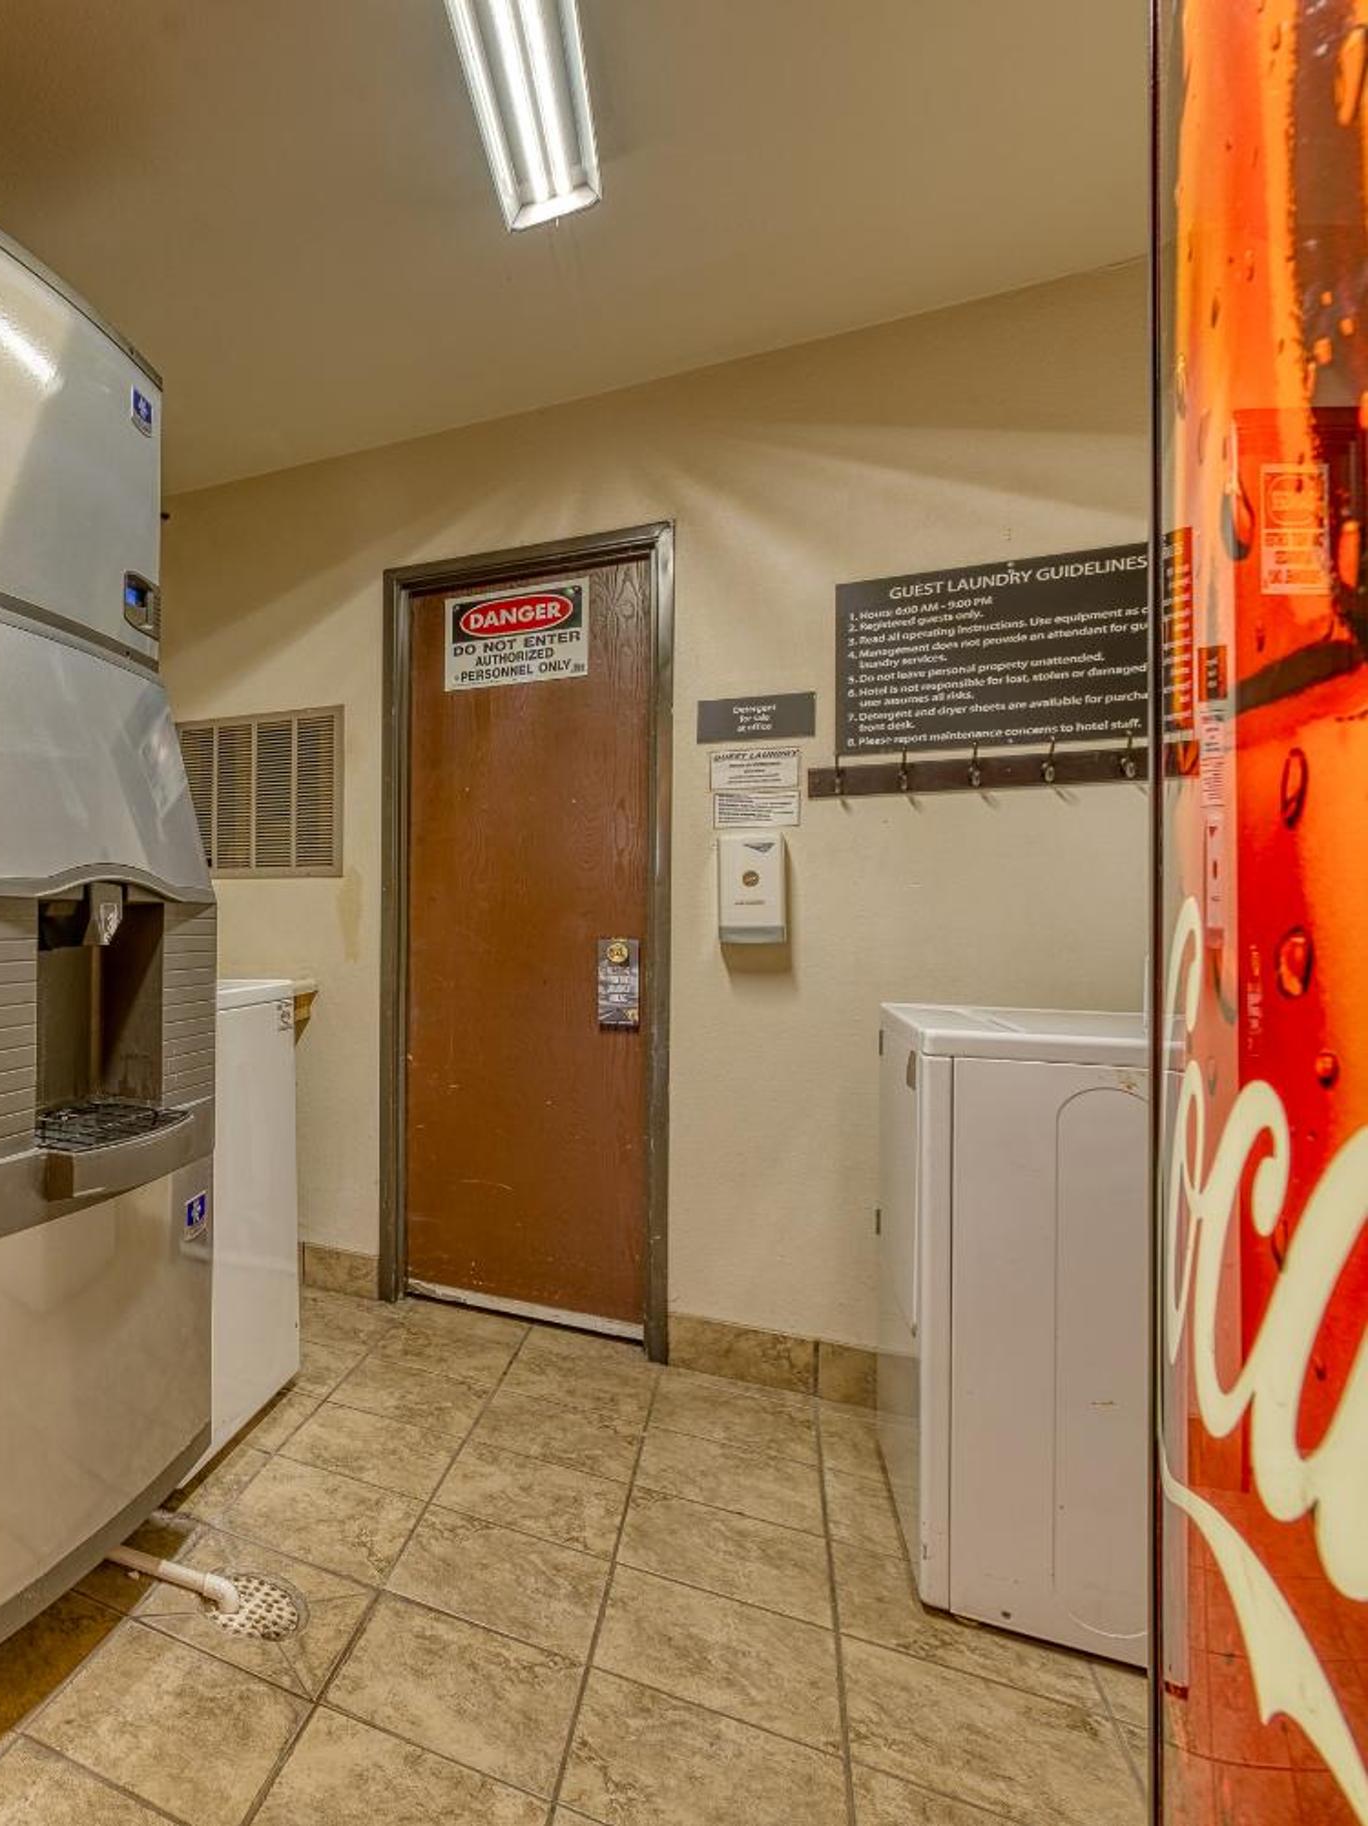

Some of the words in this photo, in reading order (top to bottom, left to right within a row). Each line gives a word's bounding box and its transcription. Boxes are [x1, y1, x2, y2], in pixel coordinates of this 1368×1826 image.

[889, 581, 944, 600] GUEST
[947, 569, 1032, 593] LAUNDRY
[1036, 554, 1148, 581] GUIDELINES
[469, 601, 562, 630] DANGER
[920, 602, 939, 612] AM
[974, 596, 993, 606] PM
[859, 633, 885, 645] Read
[887, 632, 900, 642] all
[902, 627, 955, 642] operating
[1029, 617, 1052, 627] Use
[1054, 608, 1122, 625] equipment
[1125, 606, 1139, 616] as
[860, 616, 916, 632] Registered
[917, 613, 953, 627] guests
[453, 644, 476, 657] DO
[483, 638, 517, 653] NOT
[523, 630, 581, 648] ENTER
[859, 643, 930, 659] Management
[931, 641, 959, 651] does
[961, 637, 980, 648] not
[983, 632, 1027, 649] provide
[1030, 631, 1044, 641] an
[1047, 625, 1108, 640] attendant
[1110, 622, 1128, 633] for
[460, 665, 533, 683] PERSONNEL
[539, 658, 572, 673] ONLY
[475, 647, 555, 667] AUTHORIZED
[859, 673, 875, 683] Do
[877, 671, 895, 681] not
[897, 670, 926, 680] leave
[928, 663, 976, 679] personal
[978, 659, 1029, 675] property
[1030, 651, 1106, 667] unattended.
[859, 685, 887, 697] Hotel
[889, 684, 898, 694] is
[901, 682, 920, 692] not
[921, 677, 985, 692] responsible
[987, 675, 1003, 686] for
[1033, 670, 1070, 682] stolen
[1071, 669, 1085, 678] or
[1087, 661, 1147, 677] damaged
[859, 708, 913, 722] Detergent
[915, 706, 937, 717] and
[938, 704, 966, 717] dryer
[969, 701, 1006, 713] sheets
[1008, 702, 1027, 711] are
[1029, 695, 1084, 709] available
[1085, 693, 1103, 704] for
[1105, 691, 1148, 704] purcha
[884, 695, 930, 706] assumes
[932, 692, 945, 702] all
[858, 722, 885, 732] front
[859, 735, 892, 746] Please
[893, 733, 928, 745] report
[930, 729, 1001, 741] maintenance
[1005, 725, 1059, 737] concerns
[1060, 723, 1074, 733] to
[1076, 719, 1109, 731] hotel
